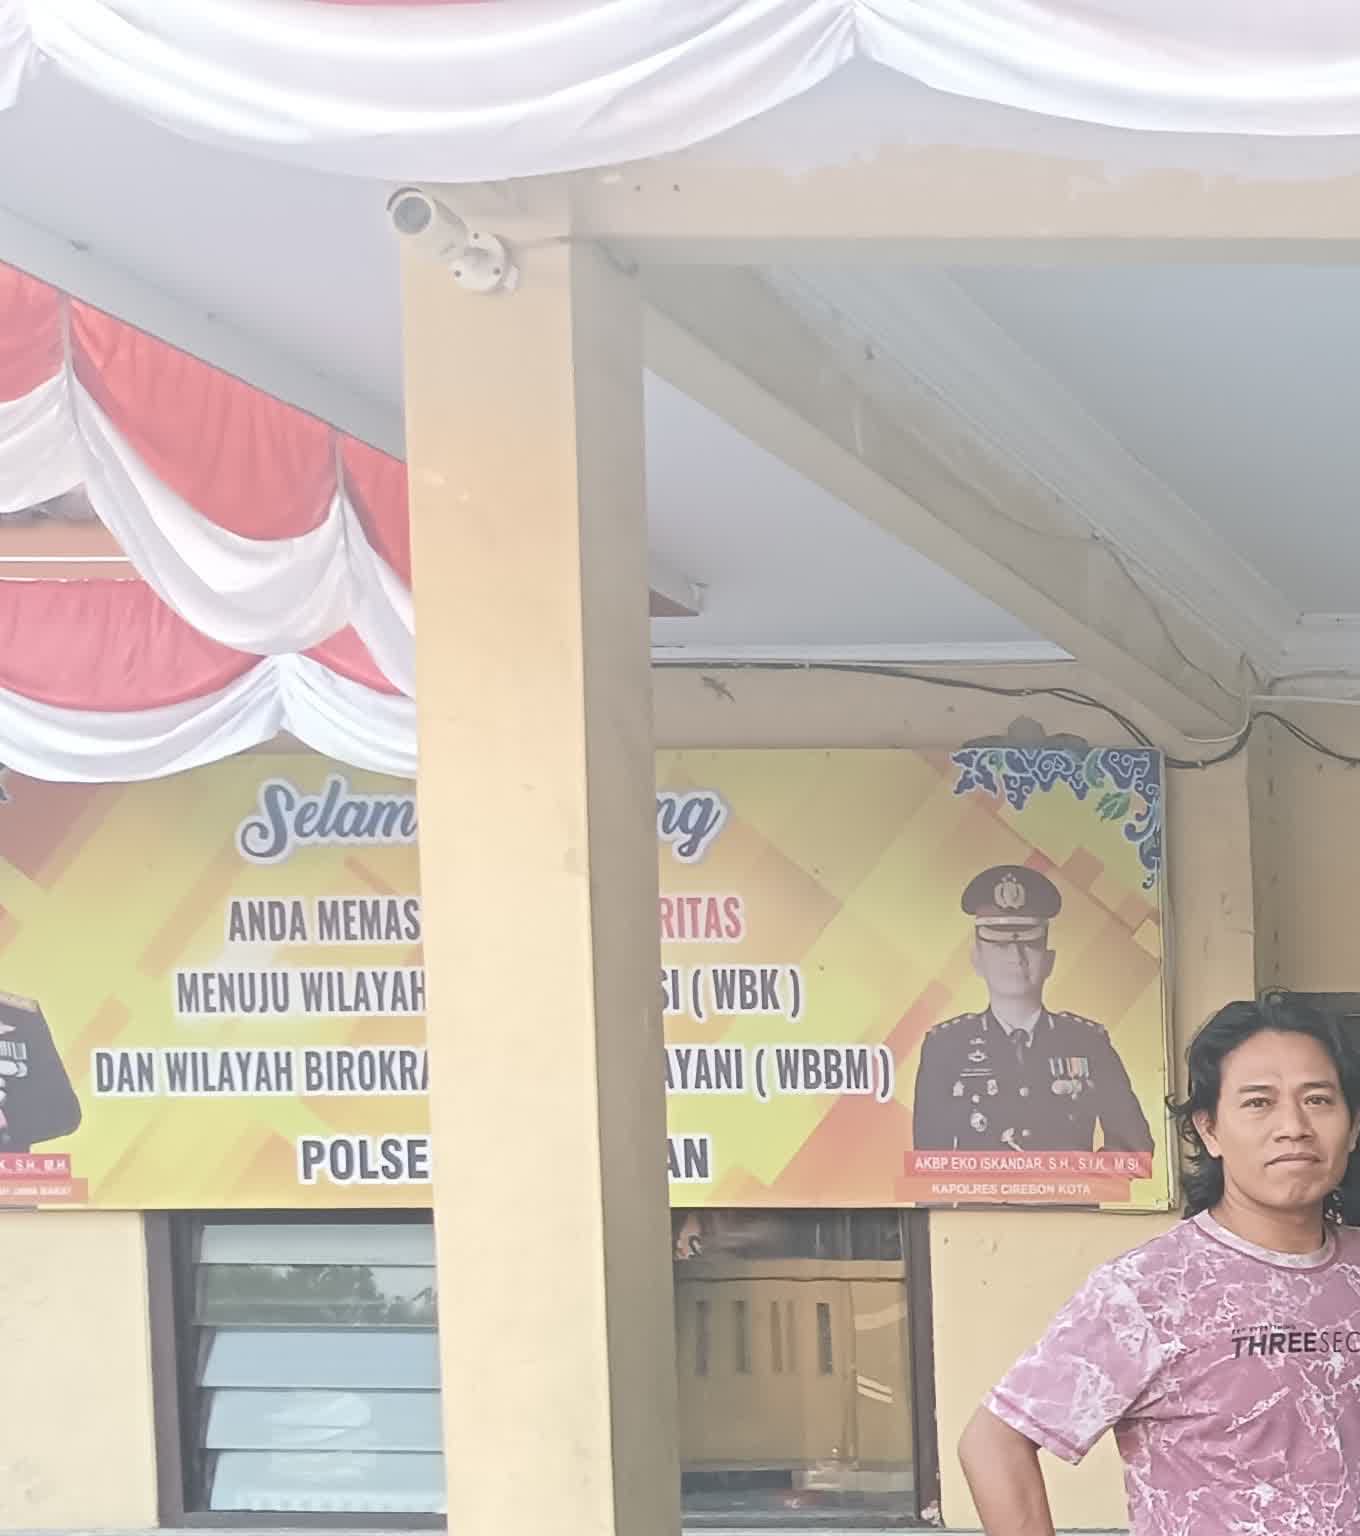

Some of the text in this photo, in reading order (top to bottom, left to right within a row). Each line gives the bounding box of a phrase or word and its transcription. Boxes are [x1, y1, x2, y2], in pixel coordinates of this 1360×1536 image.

[228, 900, 308, 942] ANDA
[318, 899, 422, 941] MEMAS
[176, 971, 291, 1013] MENUJU
[712, 969, 781, 1010] WBK
[95, 1051, 155, 1093] DAN
[165, 1050, 294, 1093] WILAYAH
[775, 1048, 870, 1090] WBBM
[951, 1156, 977, 1170] EKO
[931, 1183, 1000, 1195] KAPOLRES
[1058, 1183, 1091, 1195] KOTA
